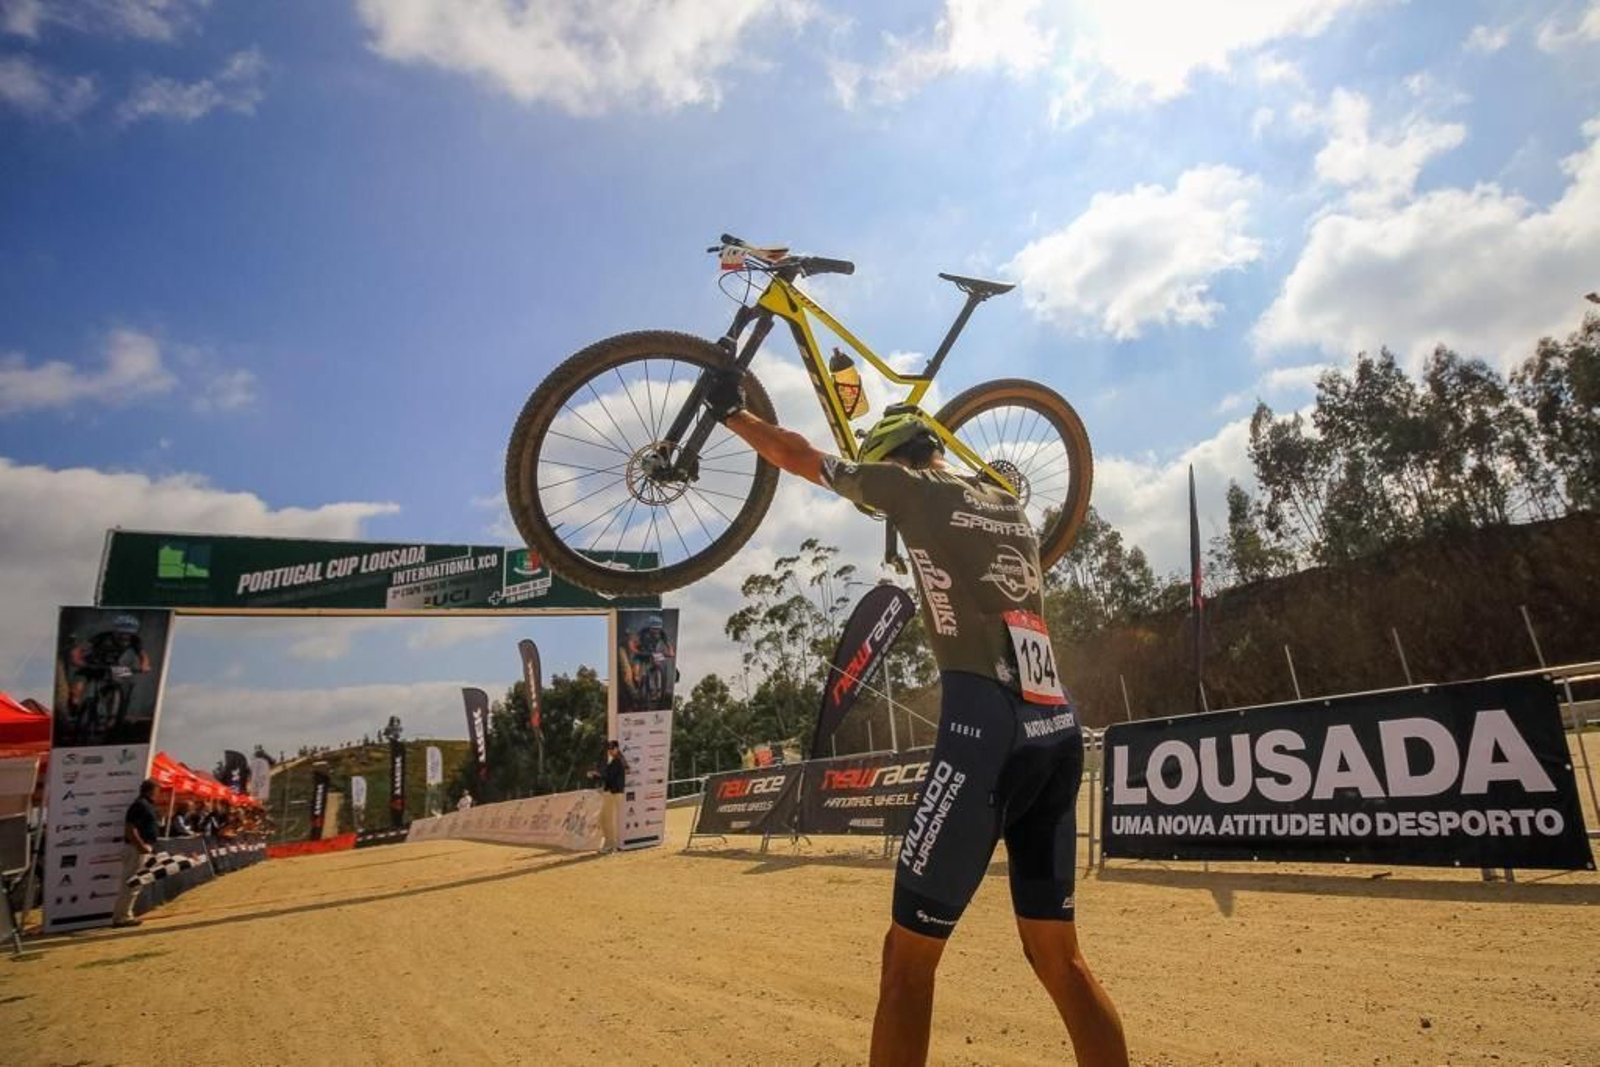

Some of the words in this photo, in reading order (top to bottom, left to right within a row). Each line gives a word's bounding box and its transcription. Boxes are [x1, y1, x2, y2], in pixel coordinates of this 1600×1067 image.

[237, 563, 323, 595] PORTUGAL
[326, 556, 359, 579] CUP
[360, 545, 426, 573] LOUSADA
[393, 557, 476, 585] INTERNATIONAL
[477, 553, 498, 571] XCO
[1021, 638, 1056, 688] 134
[1111, 708, 1558, 806] LOUSADA
[900, 760, 953, 867] MUNDO
[912, 770, 966, 876] FURGONETAS
[1111, 815, 1154, 836] UMA
[1157, 814, 1216, 836] NOVA
[1218, 813, 1325, 836] ATITUDE
[1329, 812, 1372, 836] NO
[1376, 808, 1565, 837] DESPORTO
